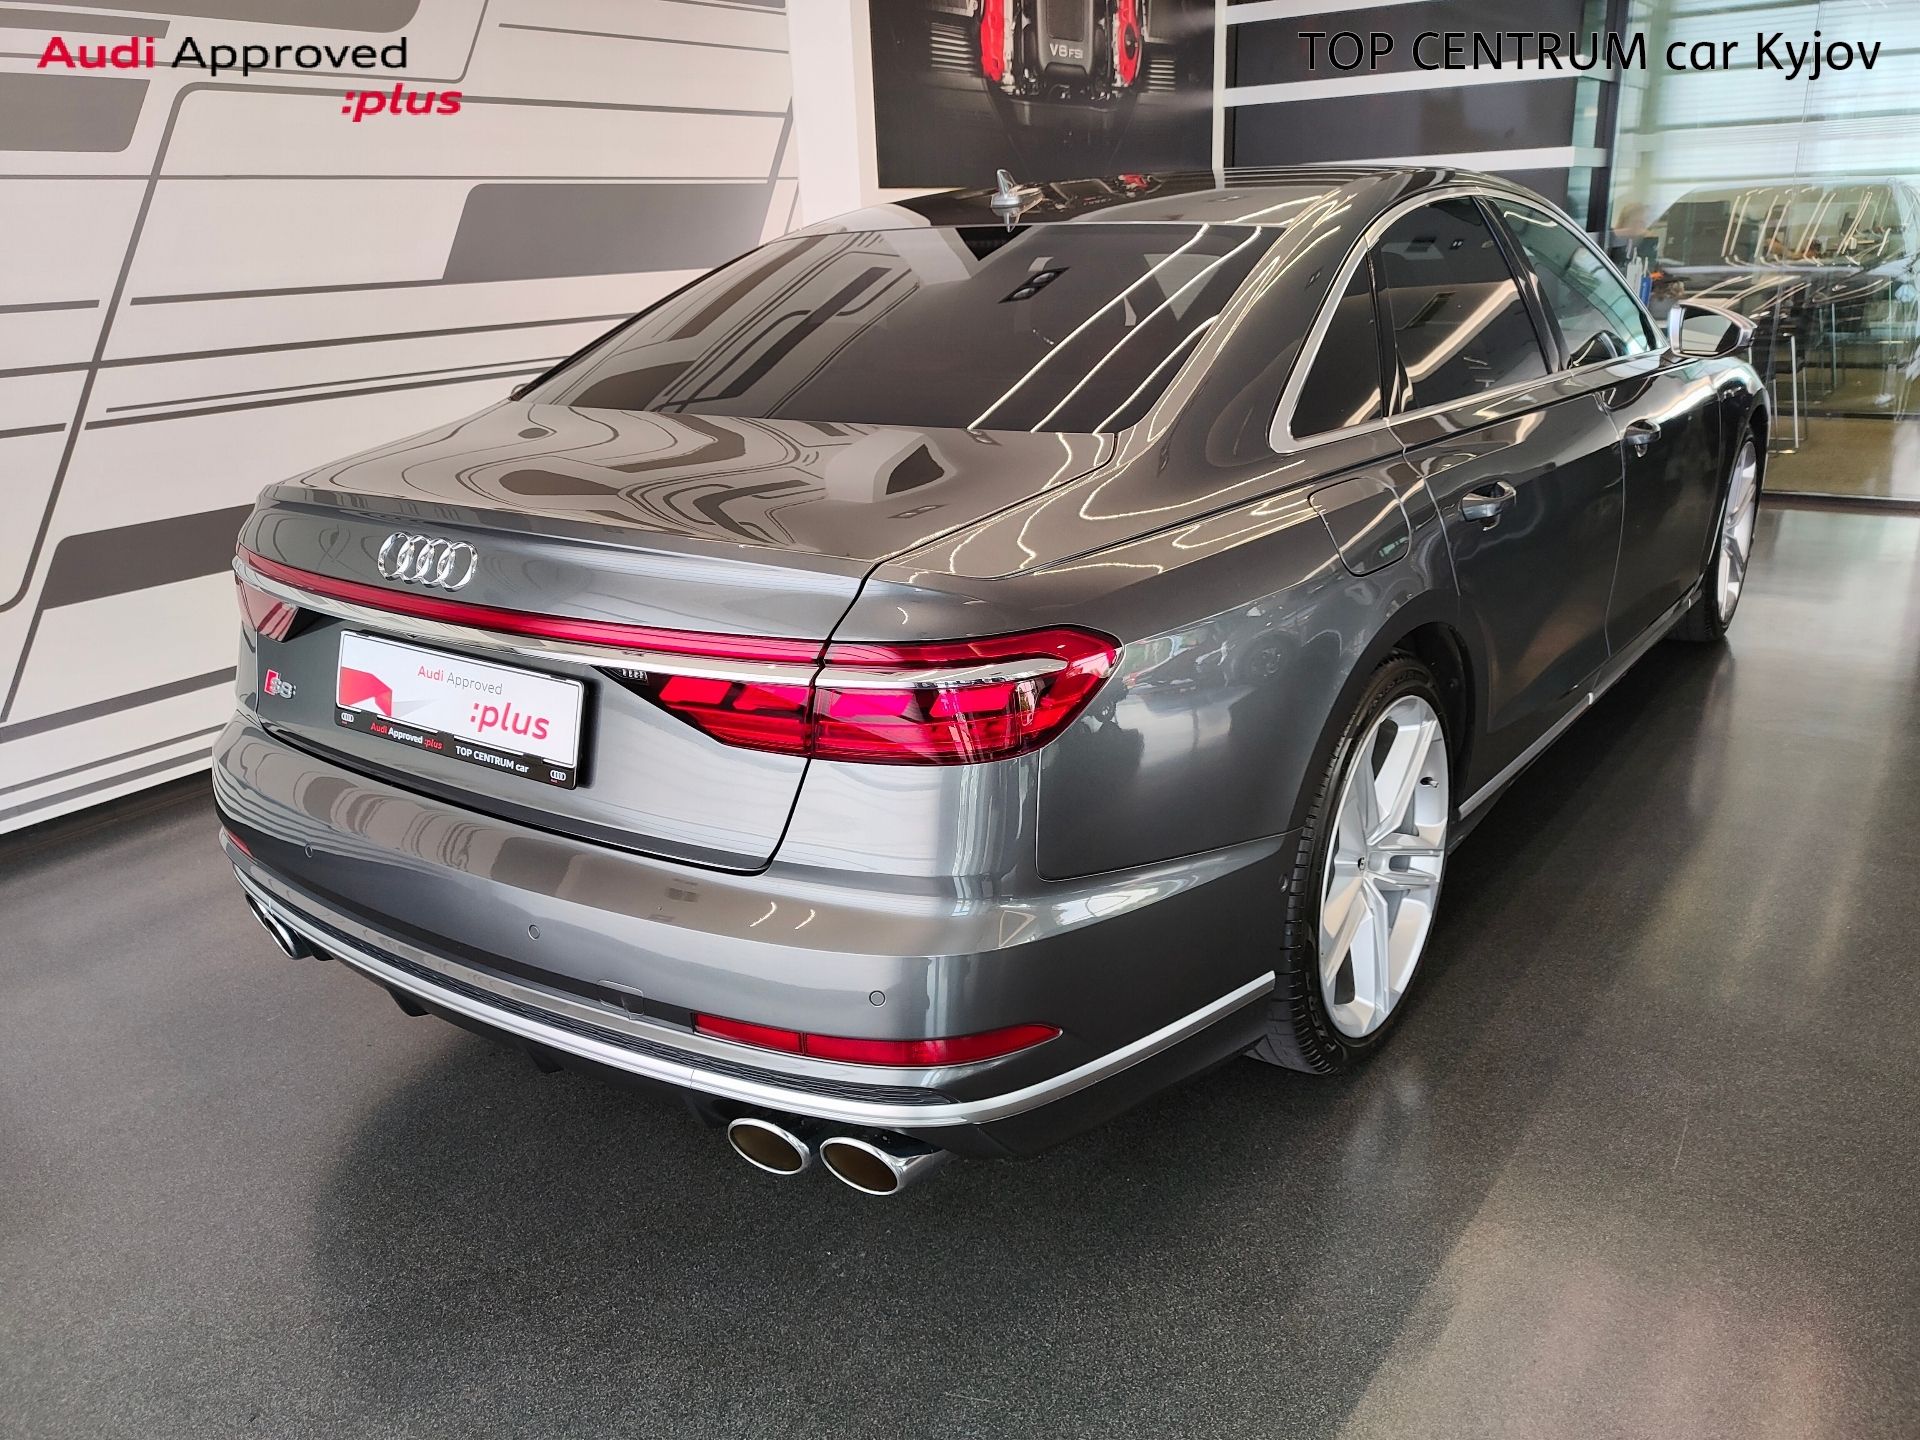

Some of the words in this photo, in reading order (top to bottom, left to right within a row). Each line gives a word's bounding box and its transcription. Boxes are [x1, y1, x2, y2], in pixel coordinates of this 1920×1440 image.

[1049, 43, 1069, 57] V8
[417, 665, 444, 682] Audi
[446, 672, 503, 695] Approved
[370, 722, 388, 734] Audi
[388, 727, 423, 745] Approved
[470, 702, 550, 740] :plus
[455, 746, 473, 758] TOP
[473, 751, 515, 769] CENTRUM
[515, 764, 530, 773] car
